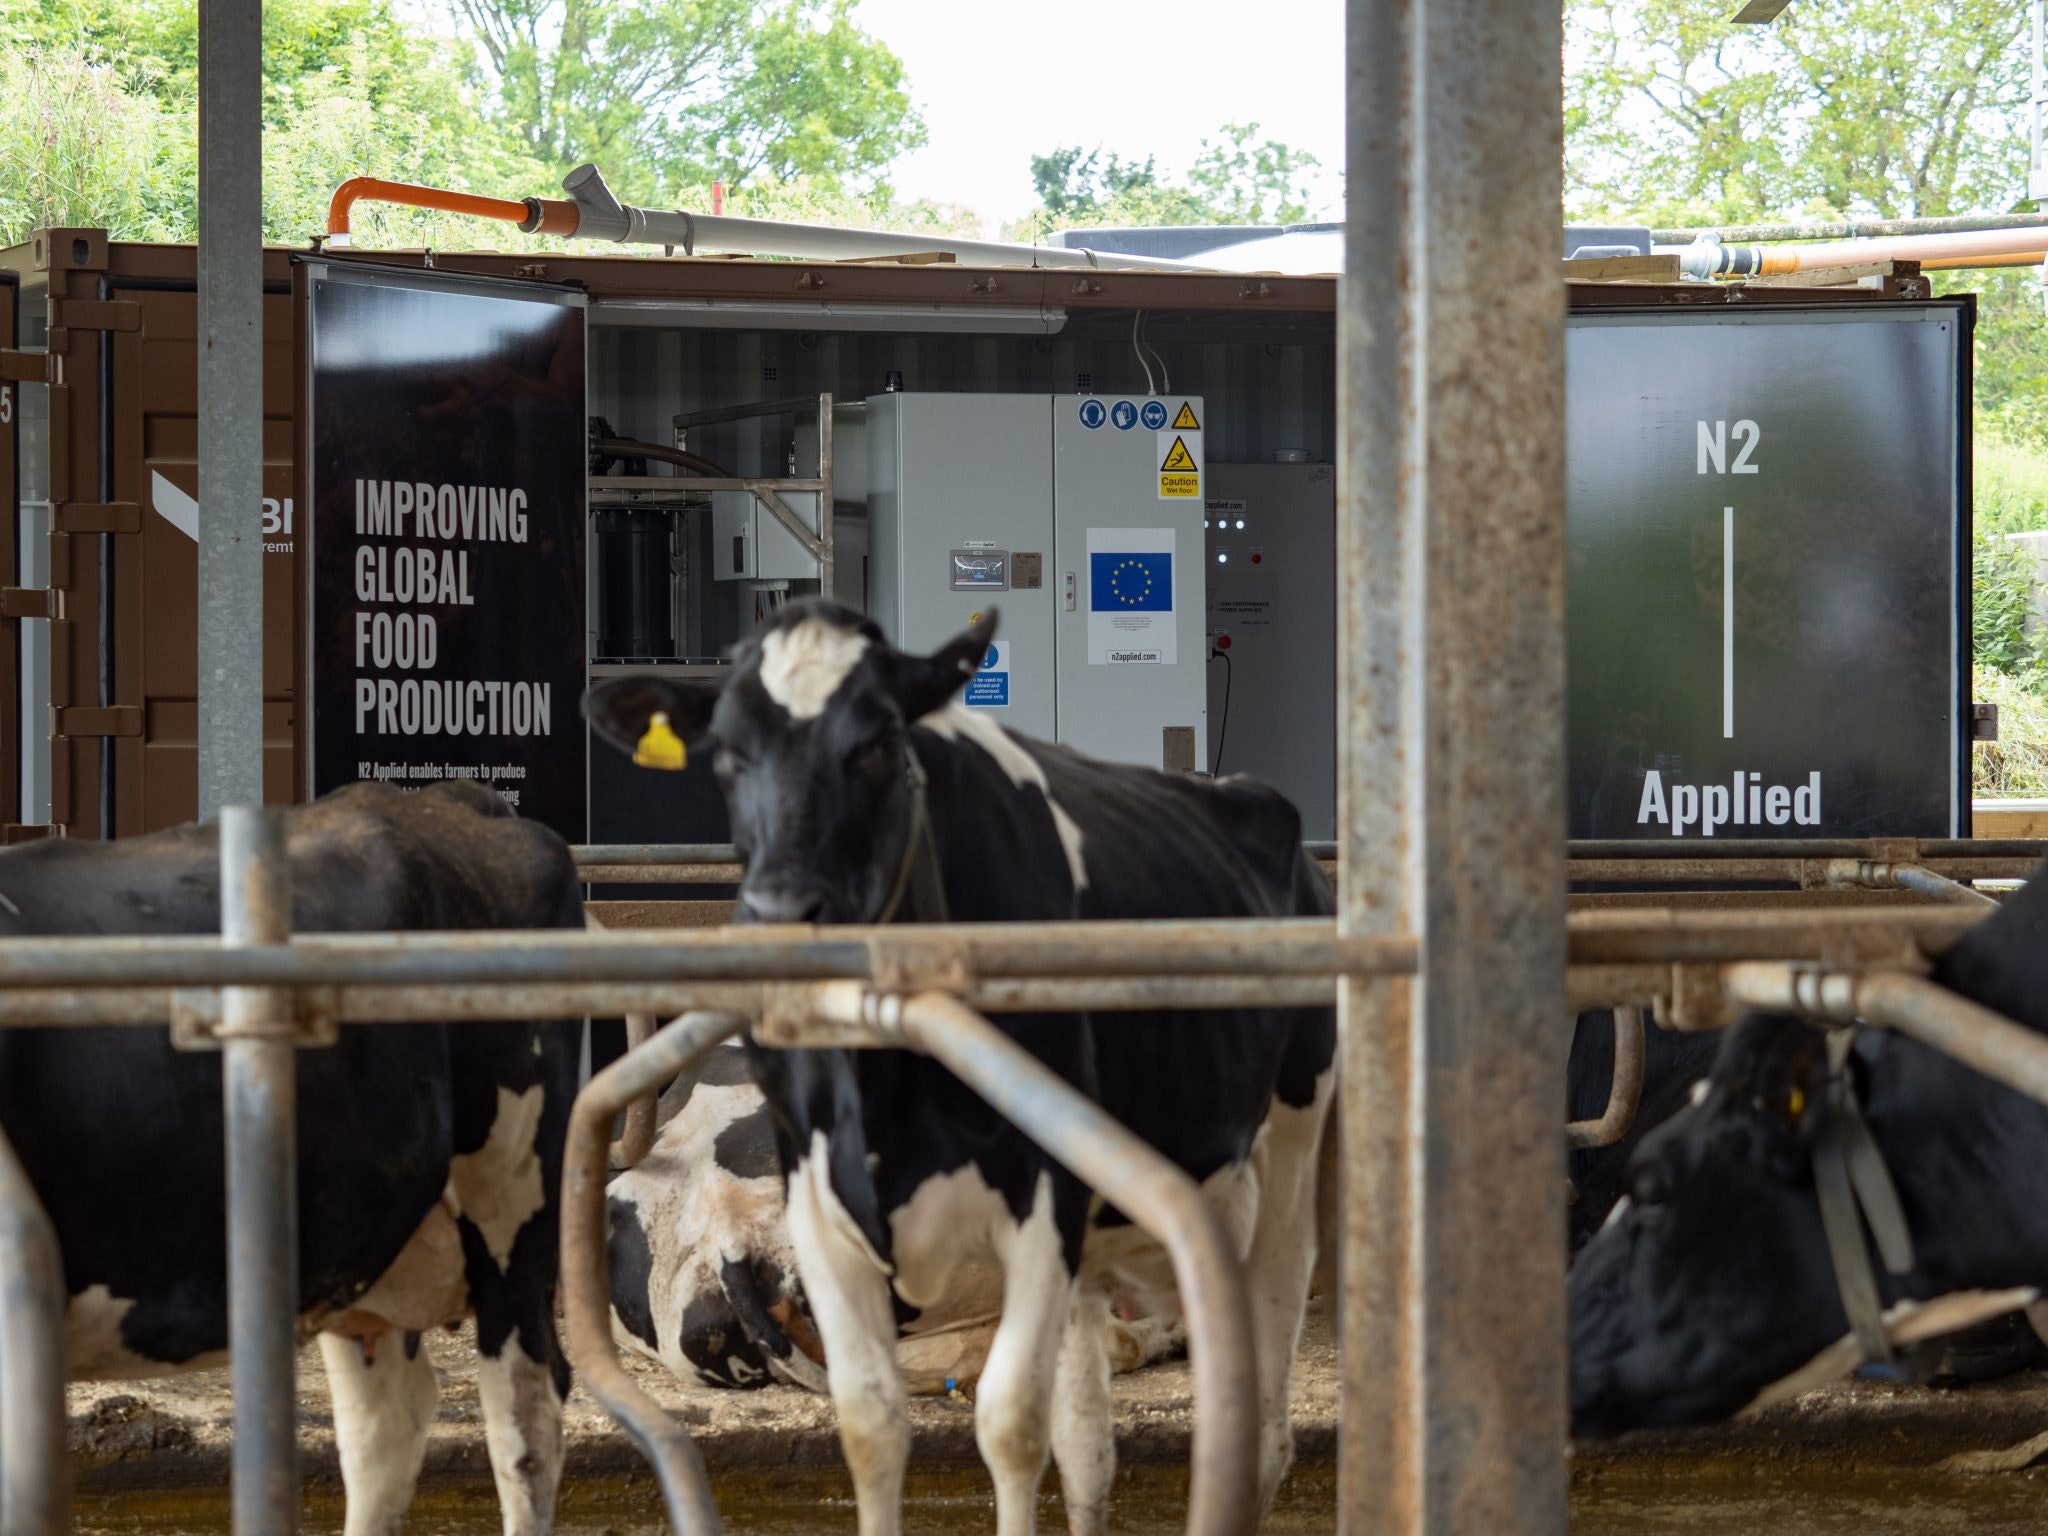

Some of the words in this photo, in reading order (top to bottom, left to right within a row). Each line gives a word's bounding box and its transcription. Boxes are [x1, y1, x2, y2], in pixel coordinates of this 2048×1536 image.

[1697, 419, 1761, 475] N2
[1161, 477, 1198, 486] Caution
[356, 479, 528, 543] IMPROVING
[355, 545, 475, 605] GLOBAL
[356, 612, 438, 670] FOOD
[1111, 651, 1157, 663] n2applied.com
[356, 678, 551, 736] PRODUCTION
[358, 762, 371, 779] N2
[373, 762, 407, 782] Applied
[409, 762, 443, 779] enables
[445, 763, 479, 779] farmers
[481, 763, 490, 779] to
[492, 763, 526, 782] produce
[1637, 770, 1821, 836] Applied
